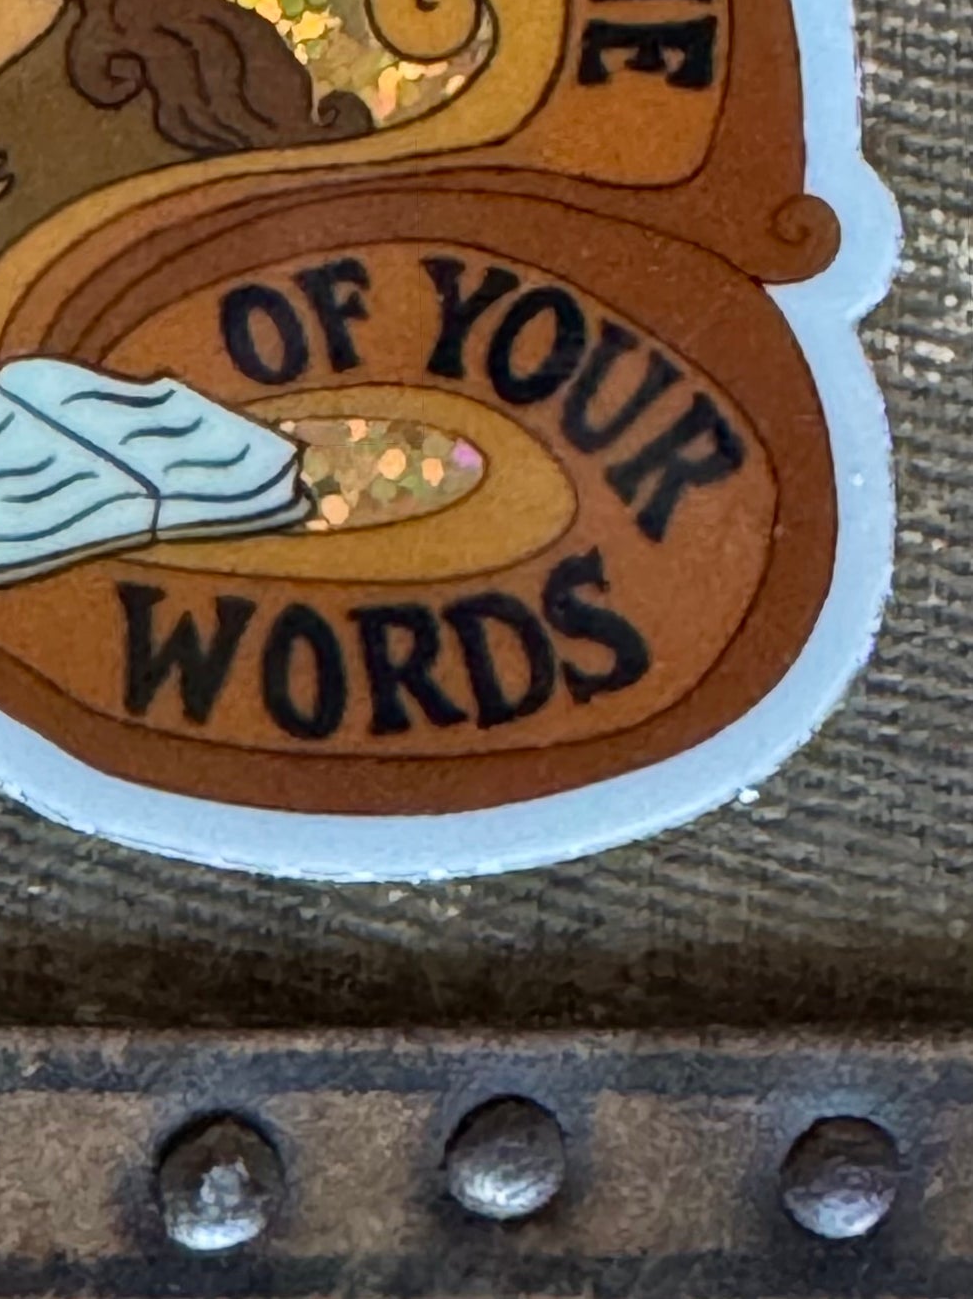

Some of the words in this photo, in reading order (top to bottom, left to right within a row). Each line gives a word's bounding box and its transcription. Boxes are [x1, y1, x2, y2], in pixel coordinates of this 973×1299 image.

[218, 258, 372, 386] OF
[420, 256, 747, 544] YOUR
[116, 547, 651, 741] WORDS
